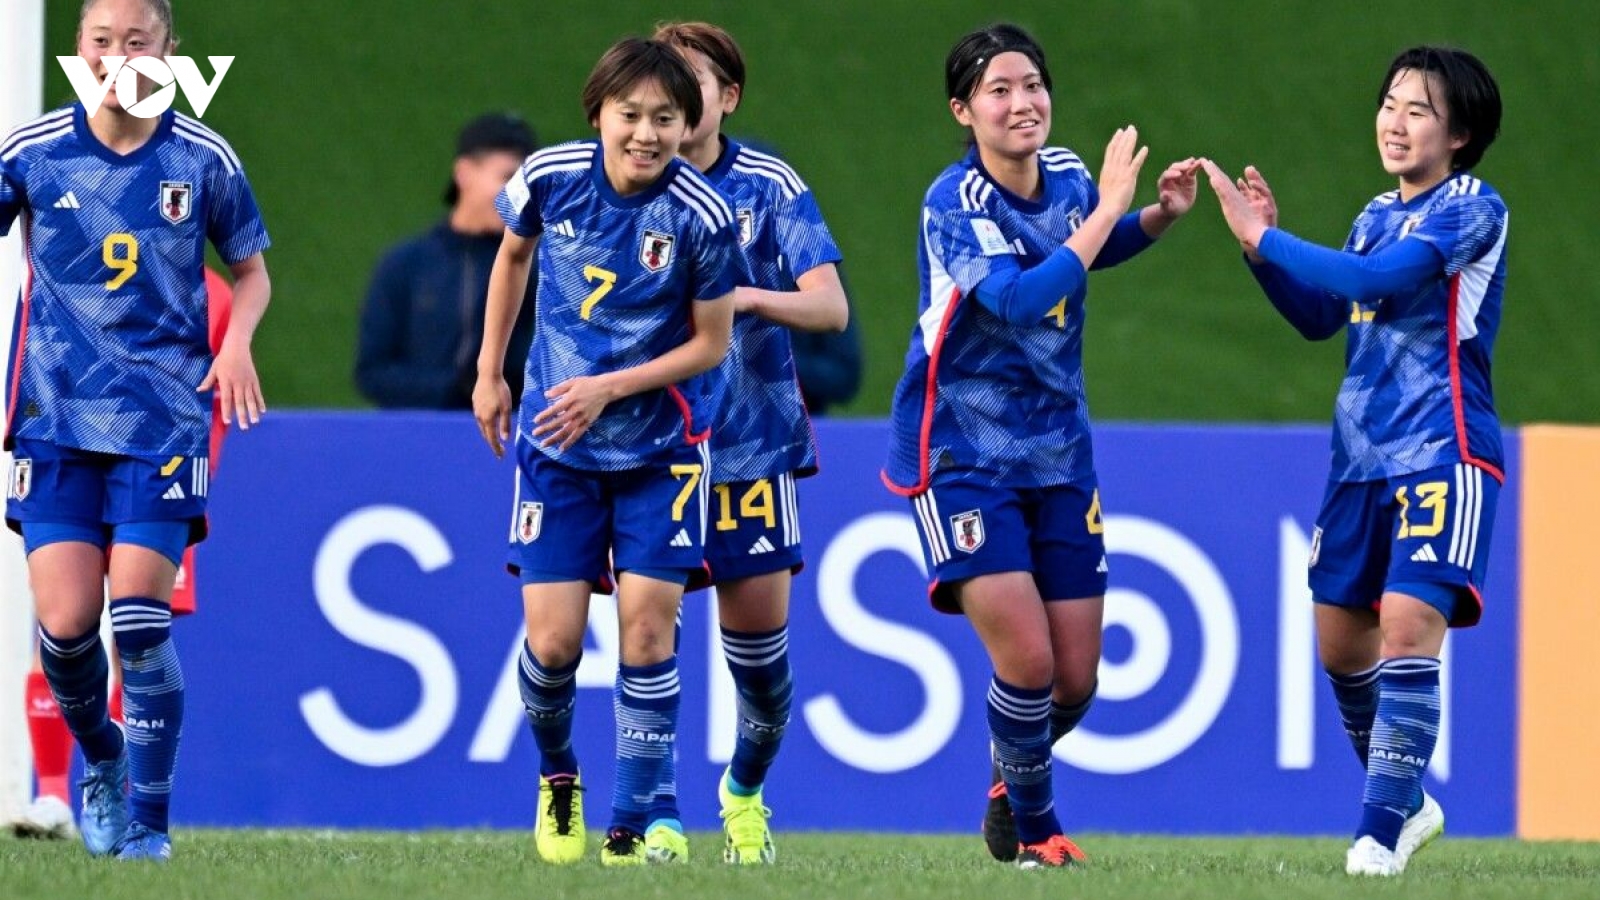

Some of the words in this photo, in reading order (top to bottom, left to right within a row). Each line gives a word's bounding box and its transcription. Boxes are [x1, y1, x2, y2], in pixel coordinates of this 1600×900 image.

[103, 232, 138, 291] 9
[580, 264, 617, 321] 7
[670, 464, 702, 522] 7
[713, 478, 776, 531] 14
[1395, 482, 1449, 540] 13
[1369, 748, 1426, 767] JAPAN
